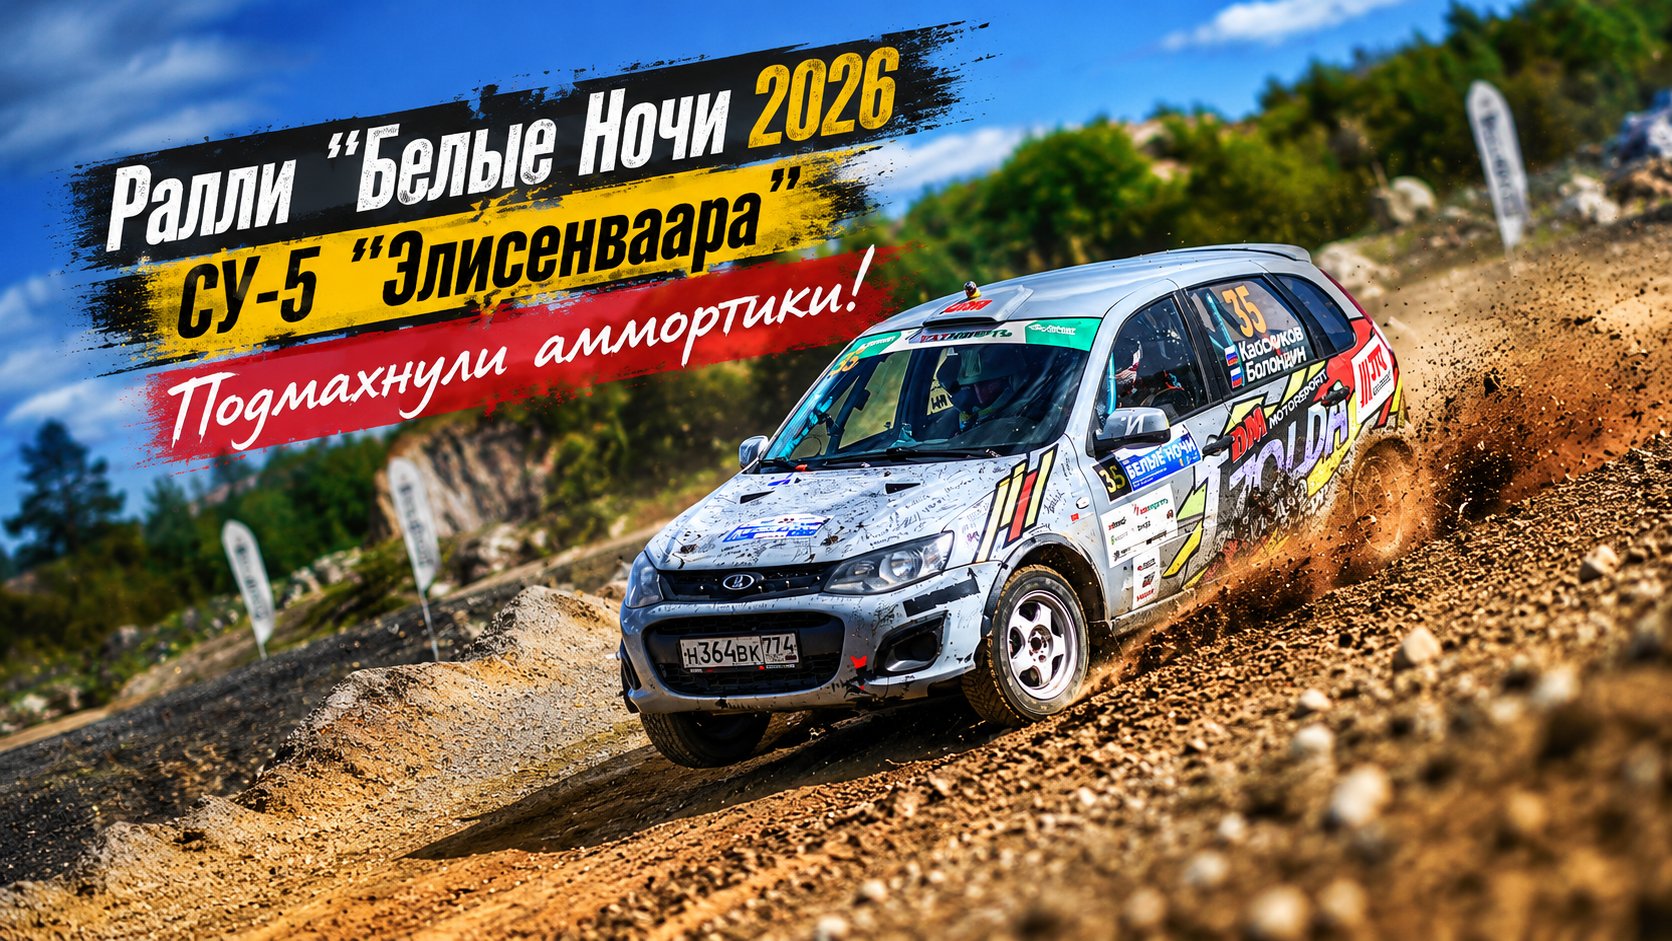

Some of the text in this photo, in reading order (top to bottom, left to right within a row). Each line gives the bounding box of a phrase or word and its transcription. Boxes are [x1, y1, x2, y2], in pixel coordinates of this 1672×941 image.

[1222, 286, 1267, 338] 35
[1230, 407, 1268, 464] DM
[1098, 465, 1126, 494] 35
[1125, 447, 1166, 480] БЕЛЫЕ
[761, 635, 795, 655] 774
